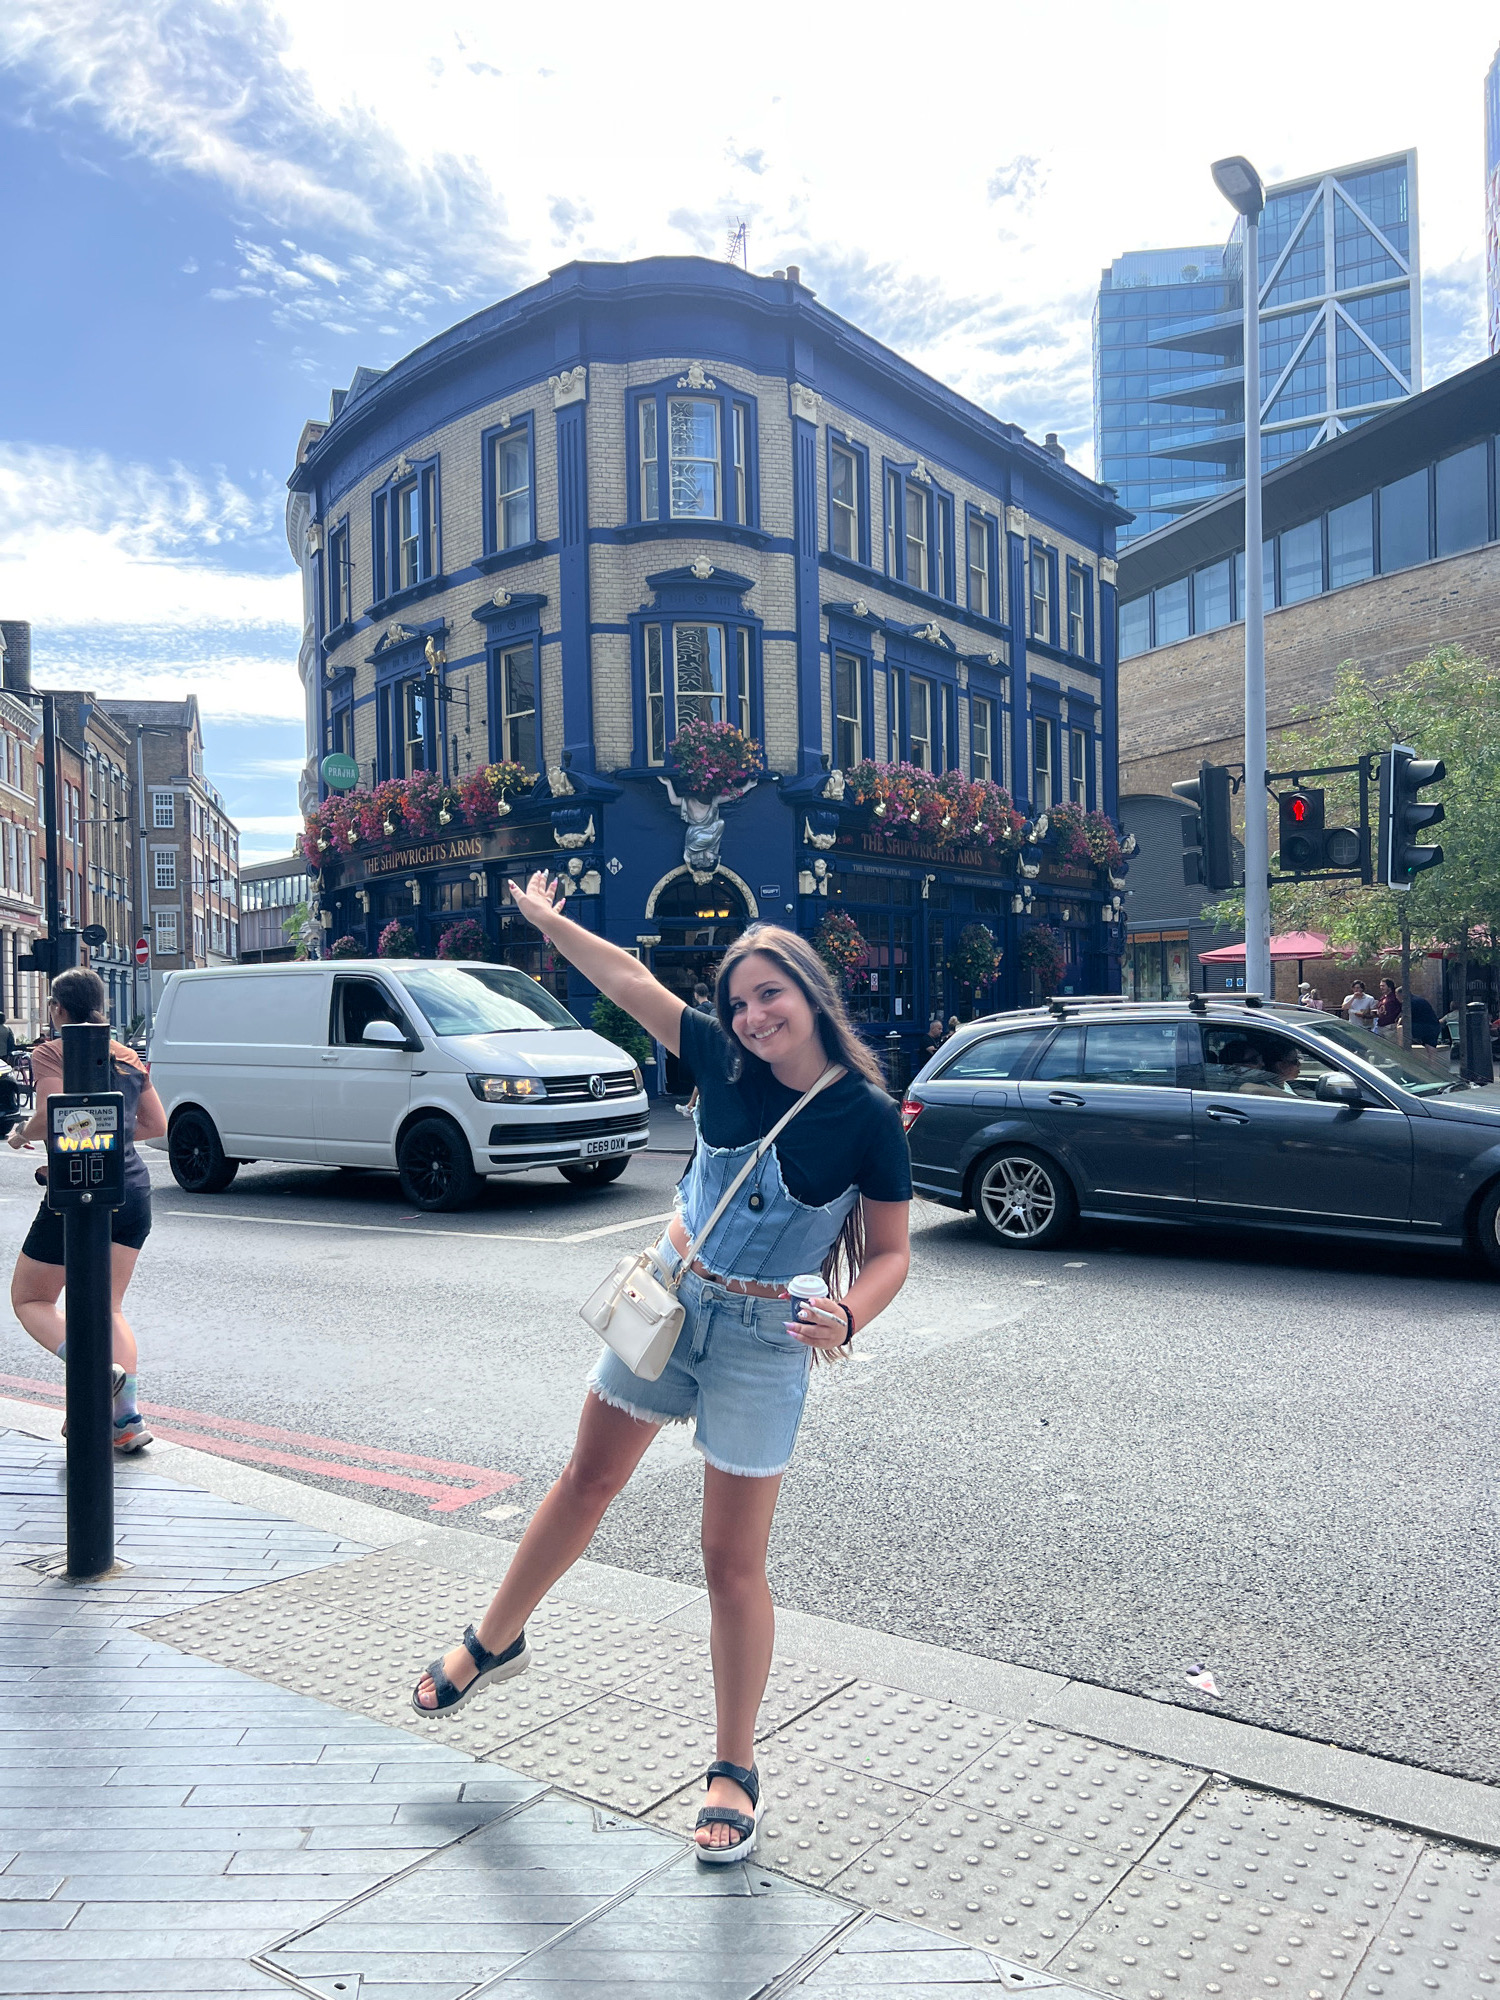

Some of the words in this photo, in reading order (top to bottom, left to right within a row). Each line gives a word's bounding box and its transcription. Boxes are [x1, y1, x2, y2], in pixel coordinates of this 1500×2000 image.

[364, 857, 379, 874] THE
[381, 843, 446, 871] SHIPWRIGHTS
[449, 838, 482, 858] ARMS
[861, 833, 883, 853] THE
[886, 839, 955, 864] SHIPWRIGHTS
[958, 850, 982, 866] ARMS
[853, 864, 864, 872] THE
[58, 1134, 114, 1151] WAIT
[587, 1140, 609, 1154] CE69
[610, 1138, 626, 1150] OXW
